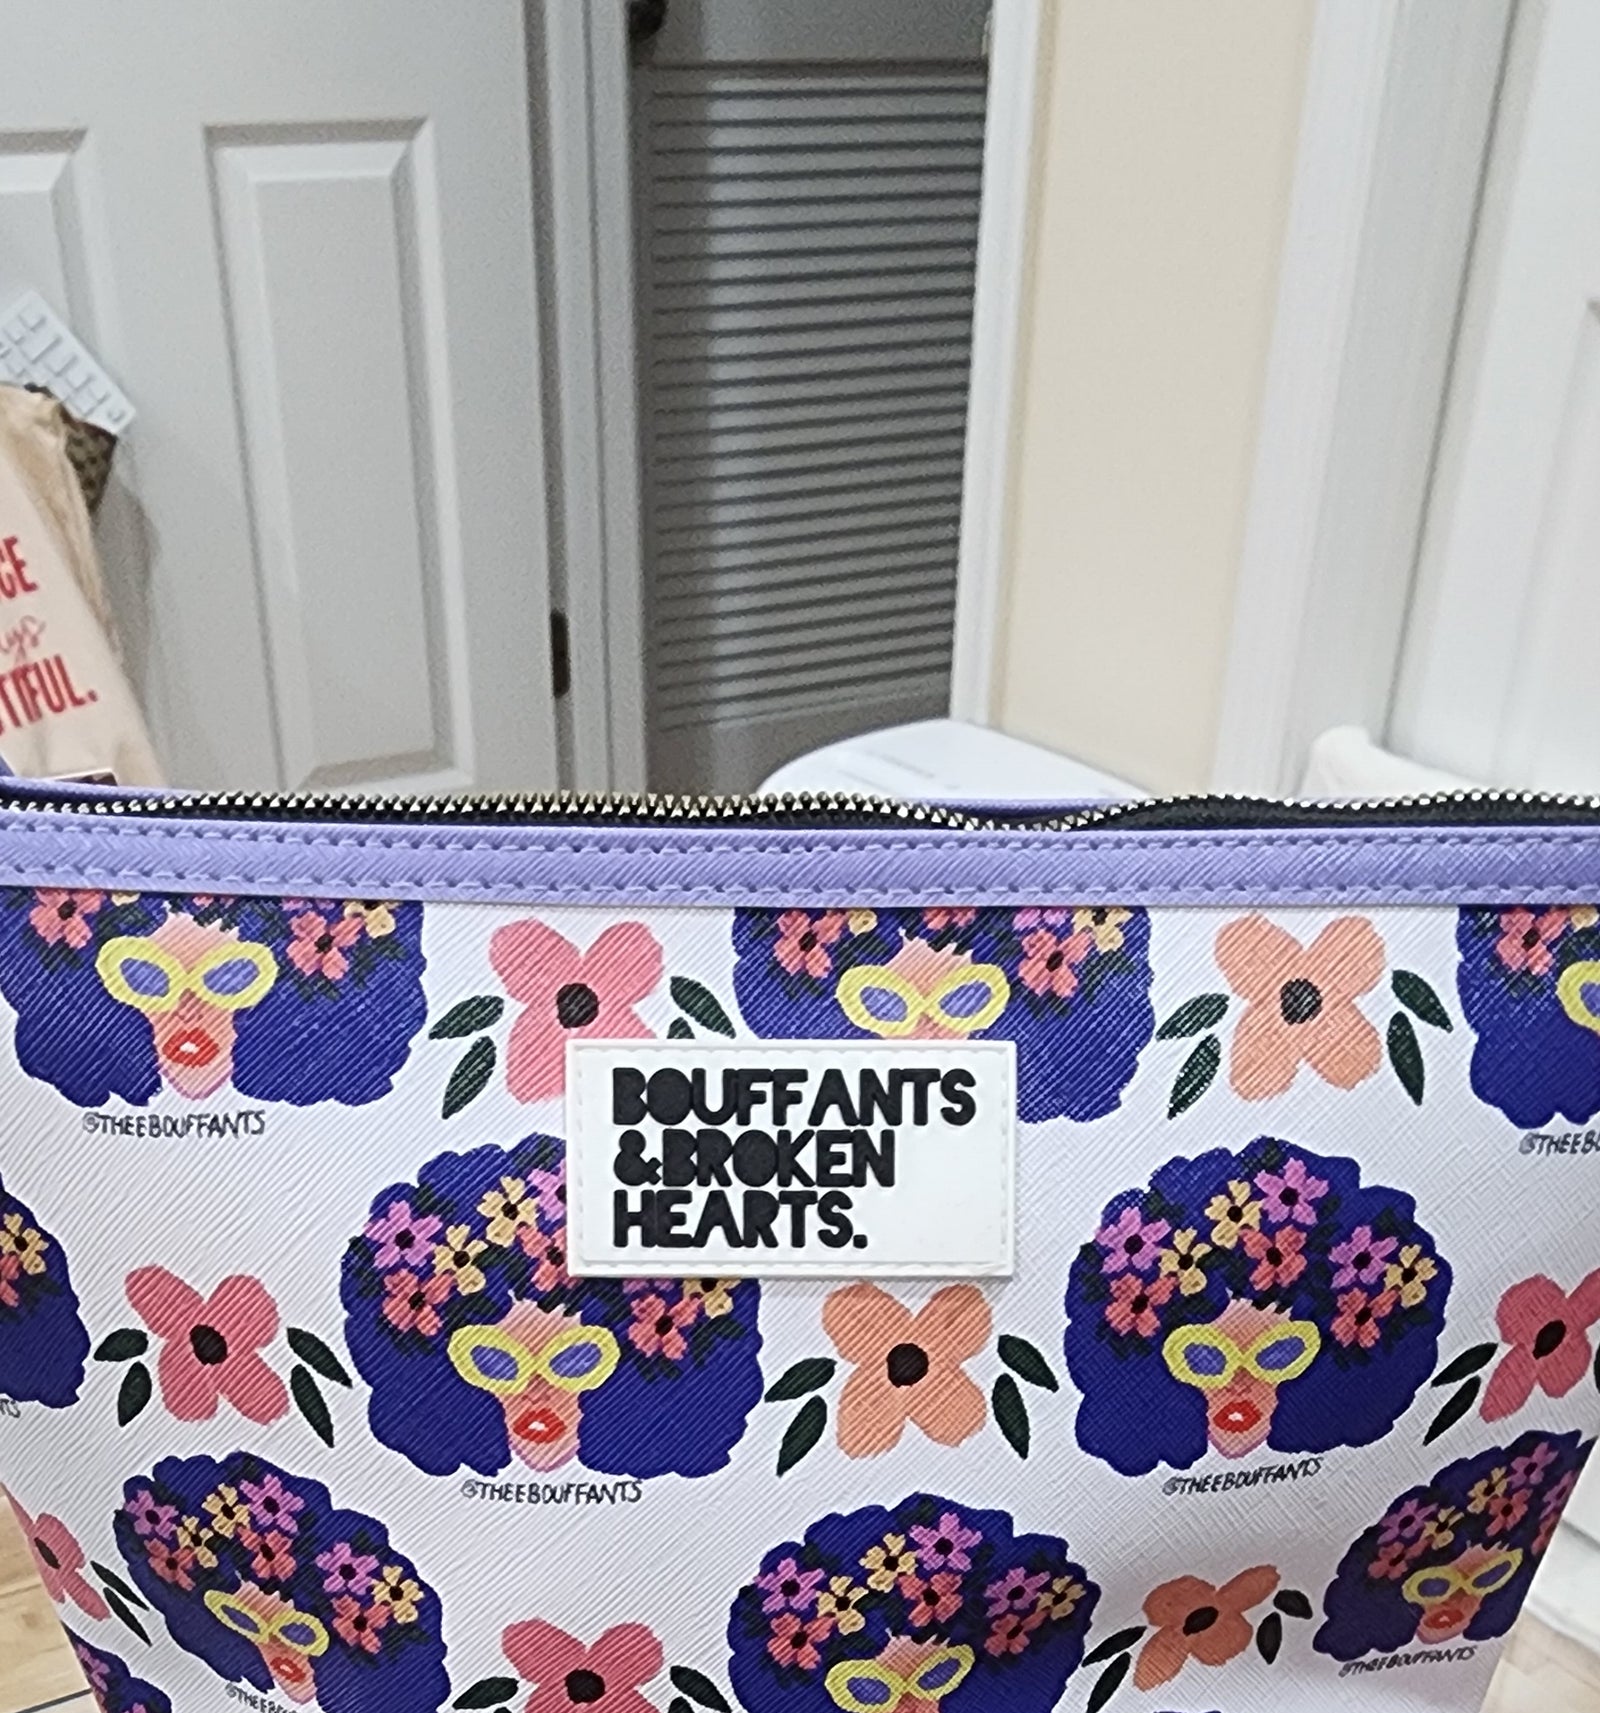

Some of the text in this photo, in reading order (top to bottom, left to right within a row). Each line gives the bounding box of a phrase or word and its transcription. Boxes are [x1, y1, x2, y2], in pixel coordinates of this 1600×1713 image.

[82, 1110, 265, 1139] @THEEBOUFFANTS
[612, 1067, 976, 1127] BOUFFANTS
[613, 1129, 896, 1187] &BROKEN
[613, 1190, 868, 1249] HEARTS.
[461, 1479, 643, 1505] @THEEBOUFFANTS
